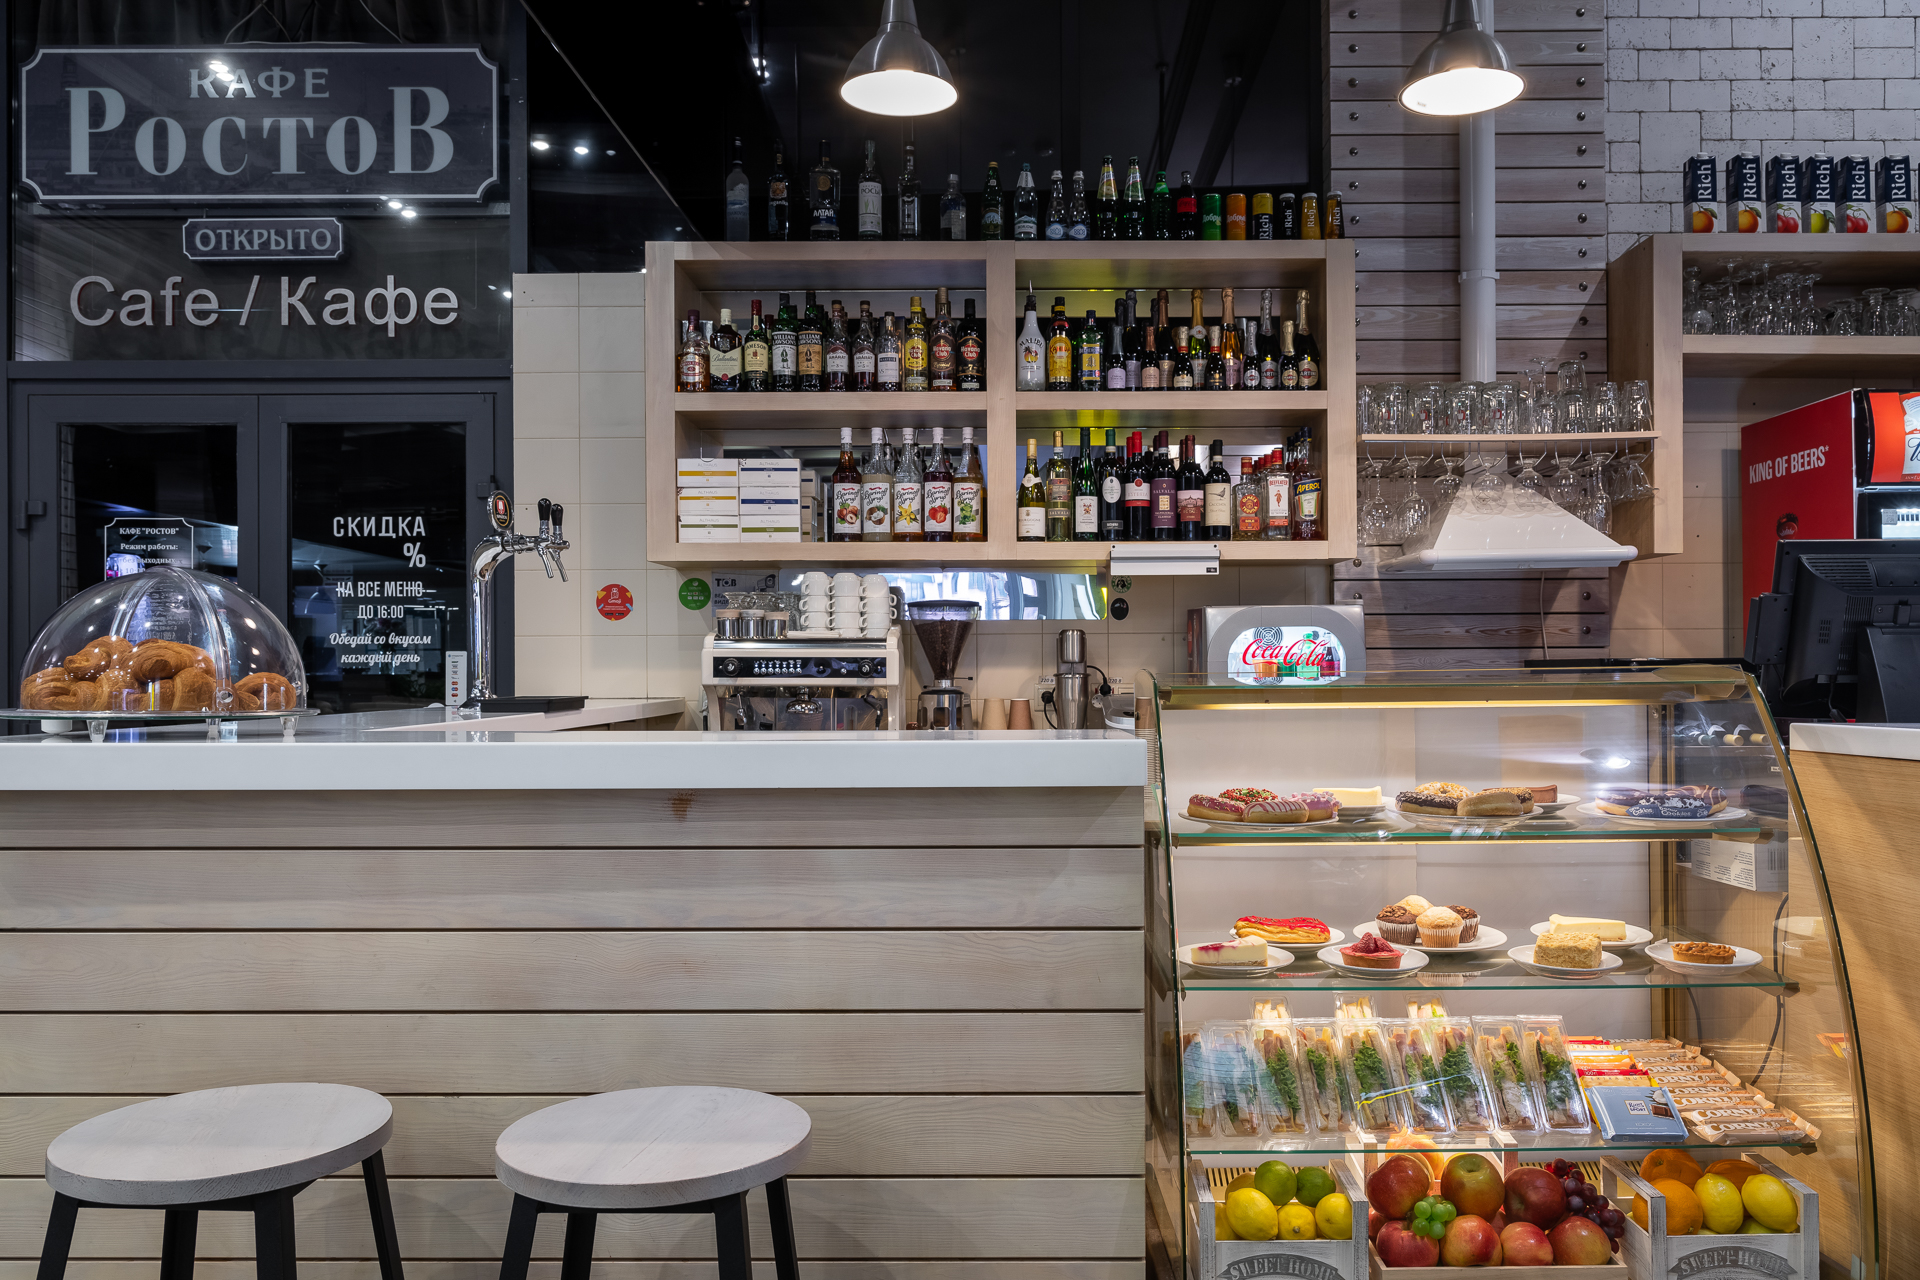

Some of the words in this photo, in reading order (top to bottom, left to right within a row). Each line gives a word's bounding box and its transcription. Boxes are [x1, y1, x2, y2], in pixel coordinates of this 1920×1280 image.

[189, 66, 330, 99] КАФЕ
[1698, 163, 1713, 199] Rich
[1743, 163, 1757, 199] Rich
[1781, 163, 1796, 199] Rich
[1816, 163, 1830, 199] Rich
[1851, 162, 1866, 200] Rich
[1891, 163, 1907, 200] Rich
[1259, 214, 1270, 240] Rich
[1285, 209, 1293, 228] Rich
[1307, 209, 1315, 227] Rich
[1333, 207, 1341, 225] Rich
[195, 228, 331, 251] ОТКРЫТО
[70, 276, 219, 325] Cafe
[281, 275, 459, 337] Кафе
[1749, 460, 1773, 484] KING
[1775, 456, 1789, 478] OF
[1296, 482, 1321, 494] APEROL
[333, 516, 426, 538] СКИДКА
[147, 543, 179, 552] работы:
[403, 542, 426, 568] %
[337, 581, 354, 597] НА
[357, 581, 381, 597] ВСЕ
[384, 581, 423, 597] МЕНЮ
[357, 605, 374, 619] ДО
[377, 605, 404, 619] 16:00
[329, 632, 372, 648] Обедай
[374, 635, 386, 644] со
[388, 633, 431, 648] вкусом
[341, 651, 392, 666] каждый
[394, 654, 420, 666] день
[1645, 1065, 1694, 1074] ORNY
[1691, 1108, 1757, 1122] CORNY
[1704, 1122, 1774, 1136] CORNY
[1230, 1258, 1283, 1280] SWEET
[1680, 1250, 1734, 1275] SWEET
